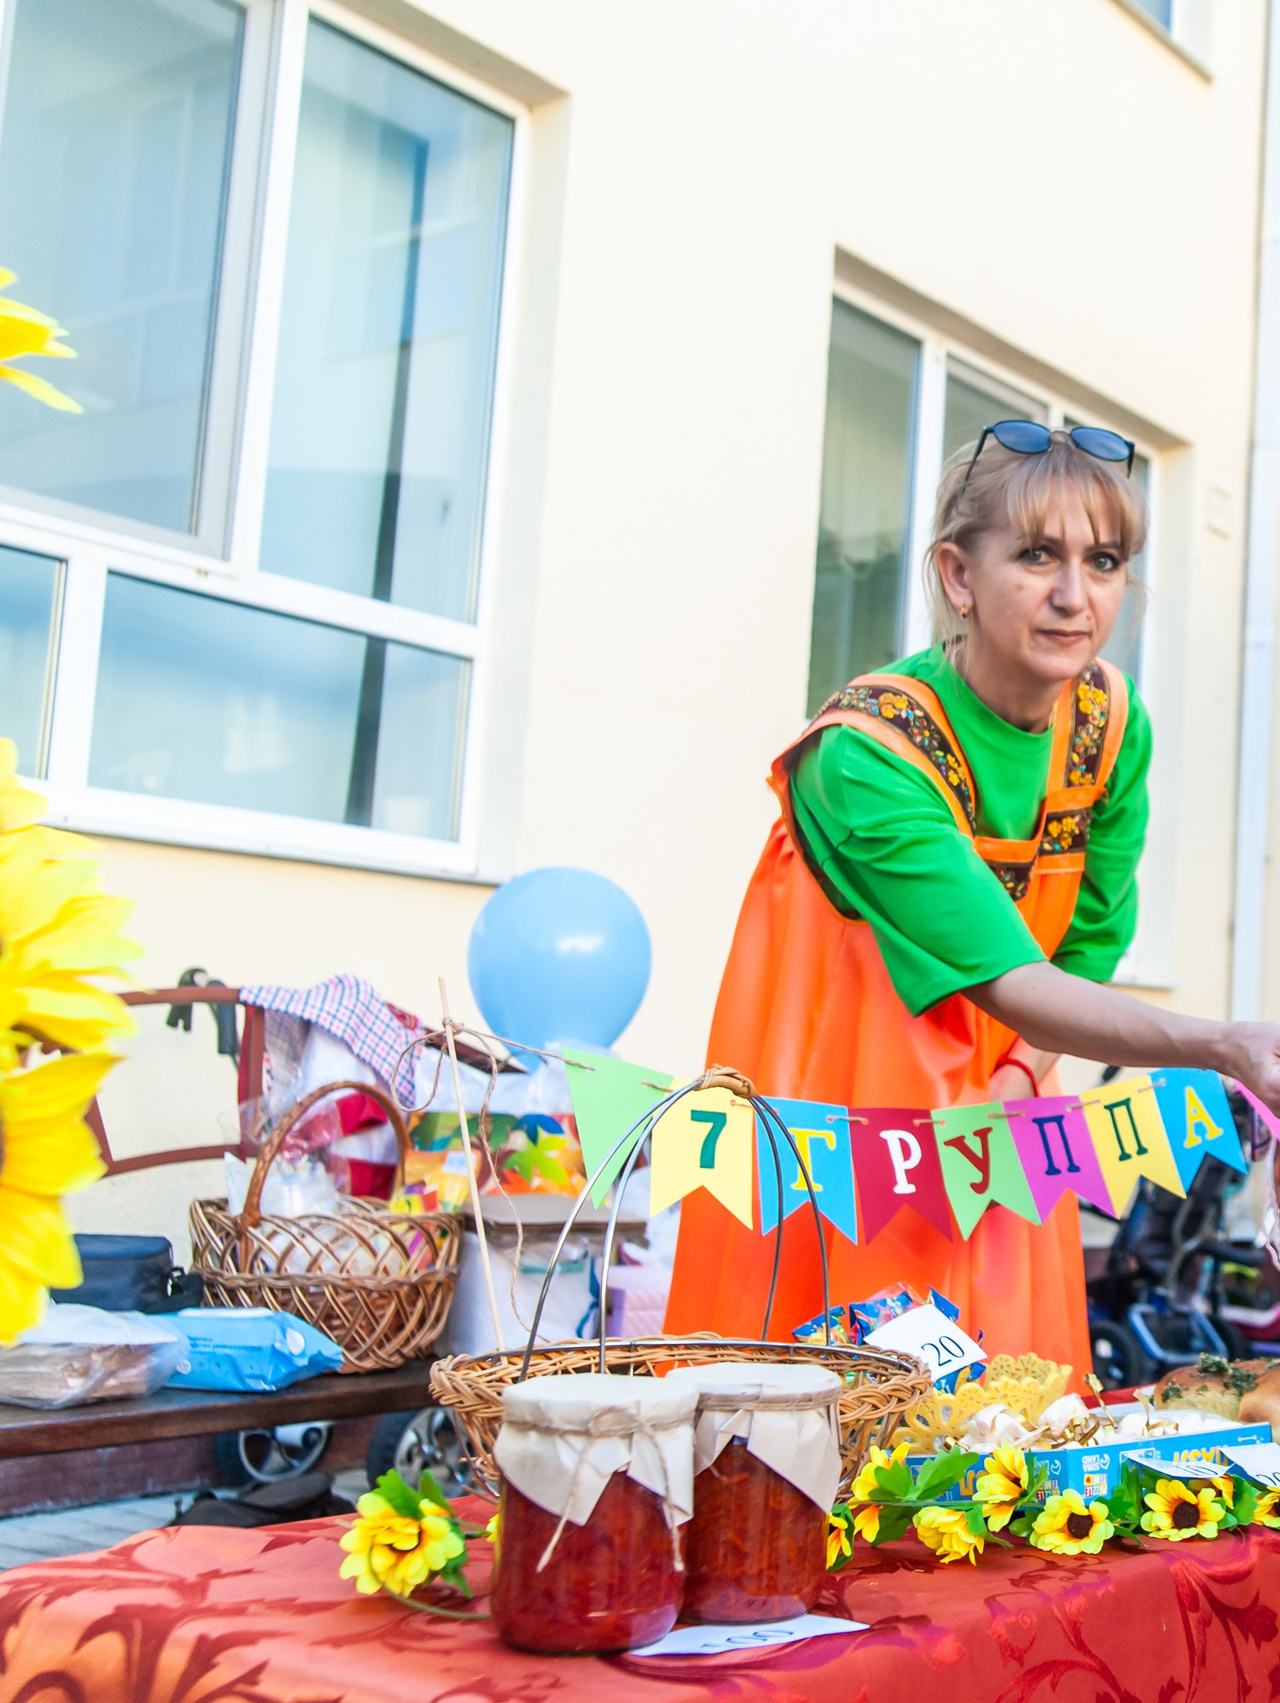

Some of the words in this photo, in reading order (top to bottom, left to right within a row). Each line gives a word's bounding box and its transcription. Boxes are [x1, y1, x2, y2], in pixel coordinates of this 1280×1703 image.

[690, 1110, 727, 1169] 7
[790, 1084, 1225, 1195] ГРУППА
[920, 1335, 965, 1367] 20
[700, 1629, 795, 1649] 100
